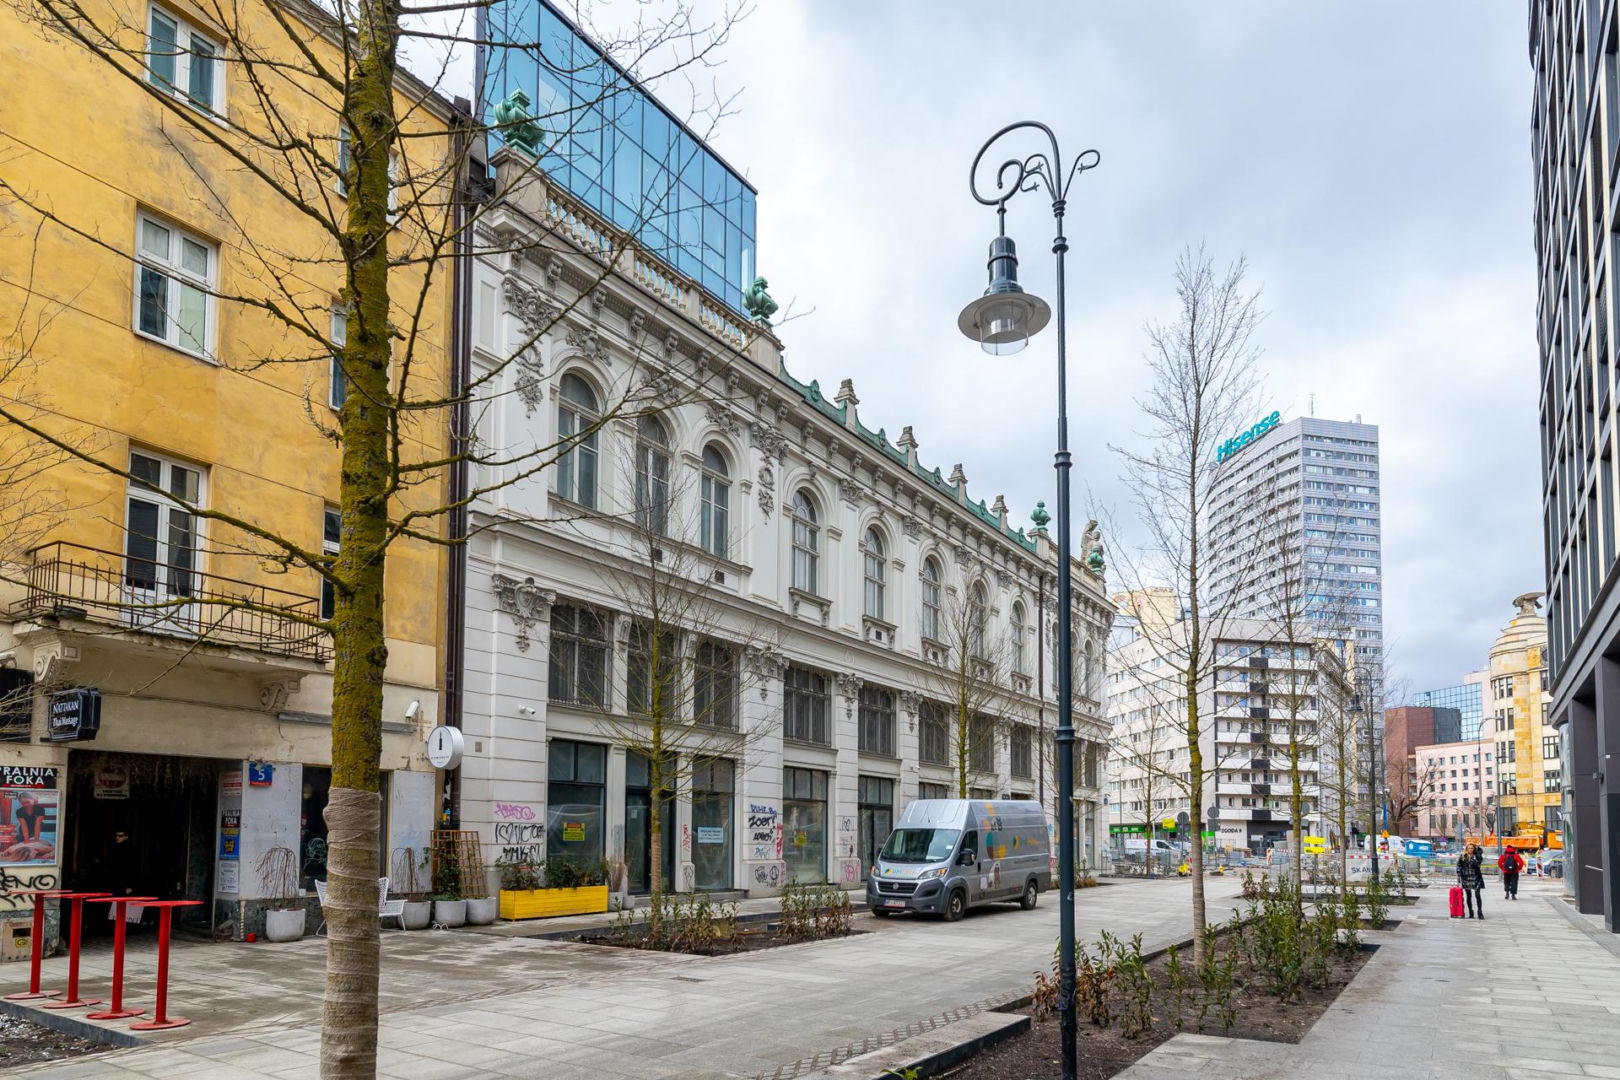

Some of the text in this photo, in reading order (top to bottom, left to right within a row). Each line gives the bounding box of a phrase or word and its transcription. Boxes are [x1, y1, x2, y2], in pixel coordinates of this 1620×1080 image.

[1217, 410, 1280, 462] Hisense
[0, 766, 54, 777] RALNIA
[258, 769, 265, 781] 5
[6, 775, 44, 785] FOKA
[1351, 866, 1373, 874] SKAN
